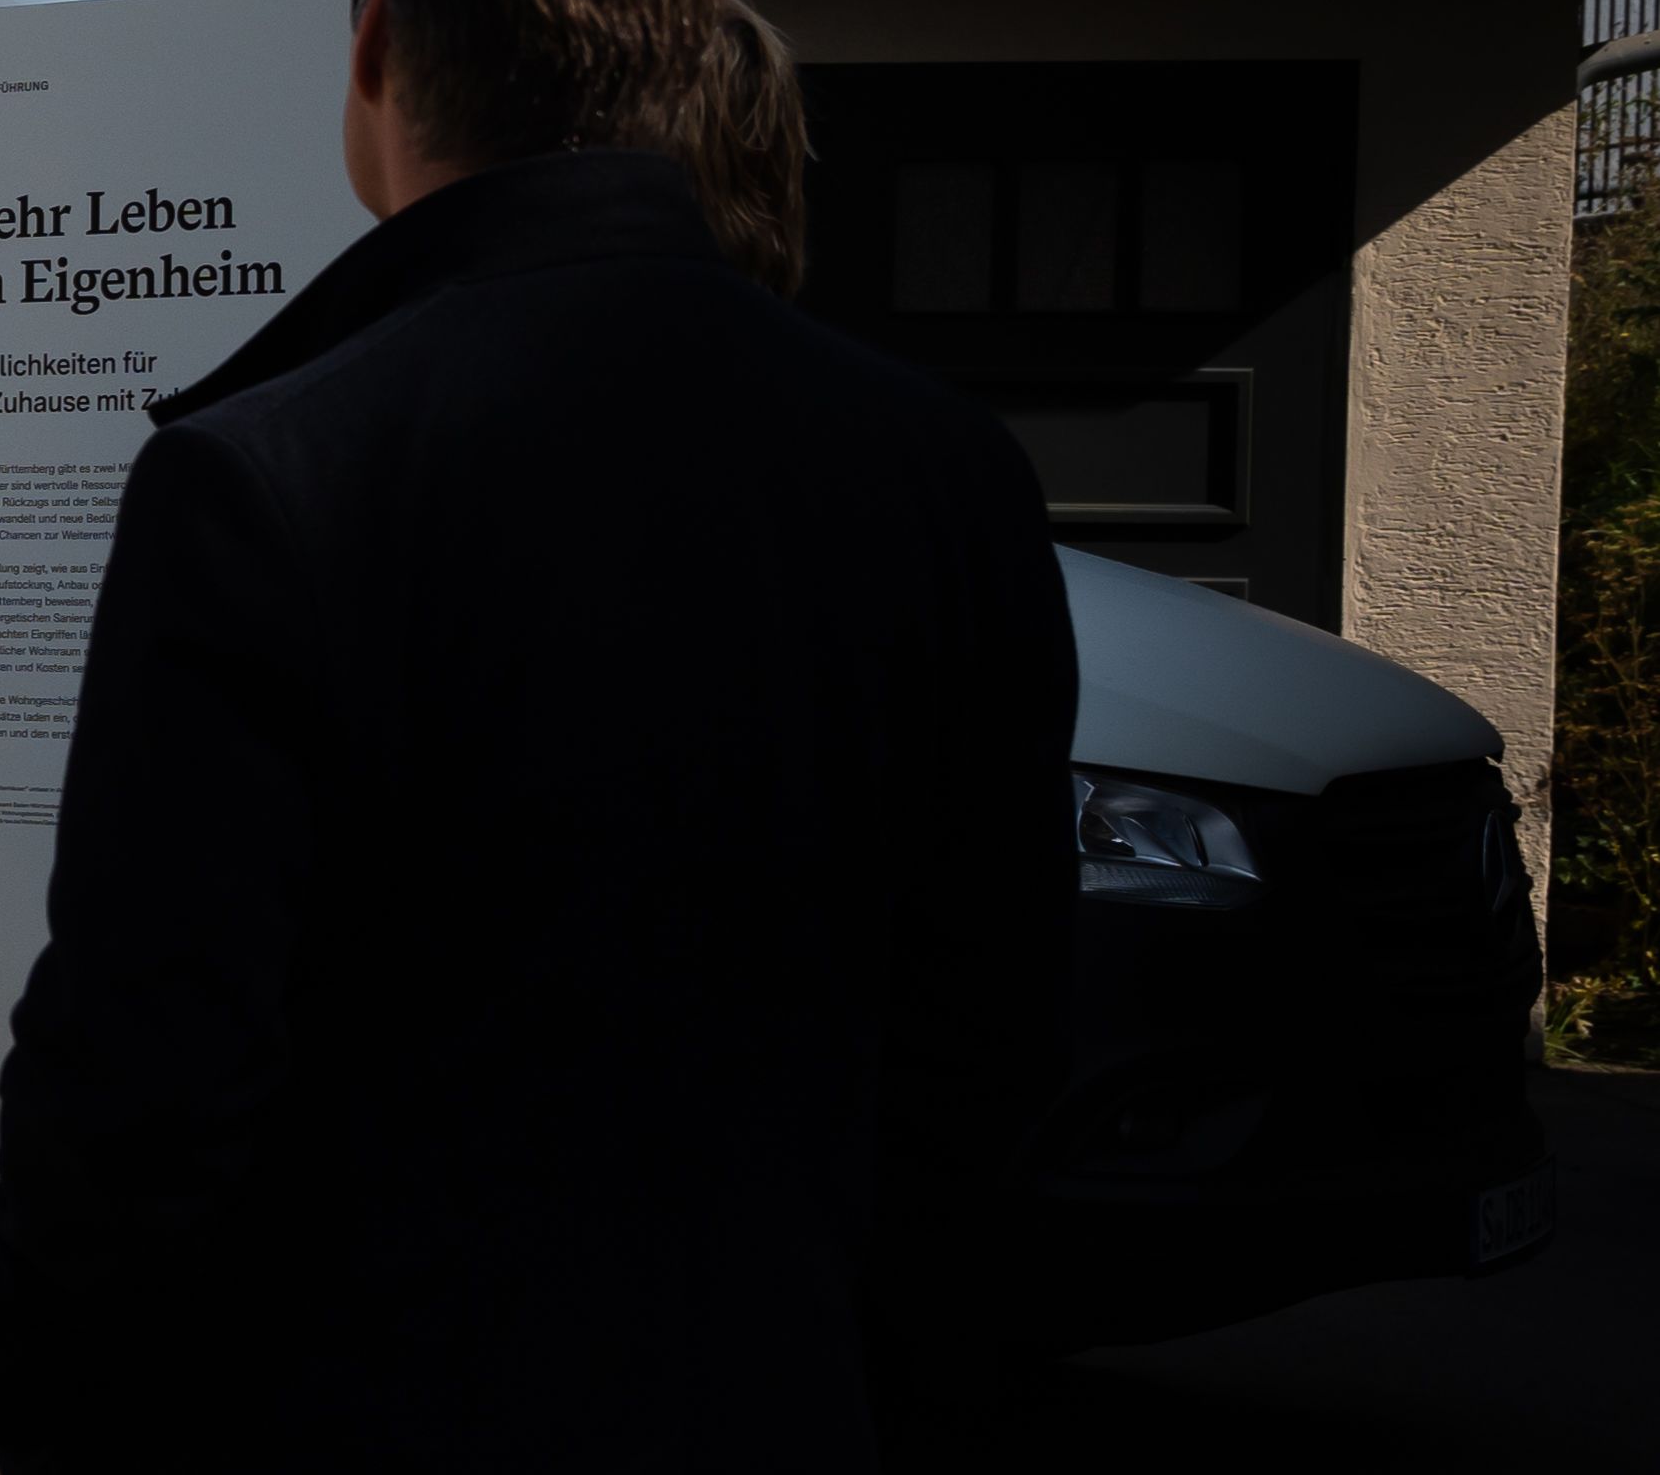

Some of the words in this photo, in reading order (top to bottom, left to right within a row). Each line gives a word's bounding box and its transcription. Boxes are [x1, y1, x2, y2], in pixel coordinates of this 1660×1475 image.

[86, 188, 235, 234] Leben
[20, 252, 287, 314] Eigenheim
[123, 350, 157, 373] für
[97, 389, 135, 411] mit
[57, 464, 76, 475] gibt
[79, 465, 90, 475] es
[92, 463, 115, 475] zwei
[11, 481, 31, 490] sind
[51, 497, 70, 508] und
[72, 497, 89, 508] der
[38, 514, 57, 523] und
[56, 579, 88, 589] Anbau
[9, 729, 28, 737] und
